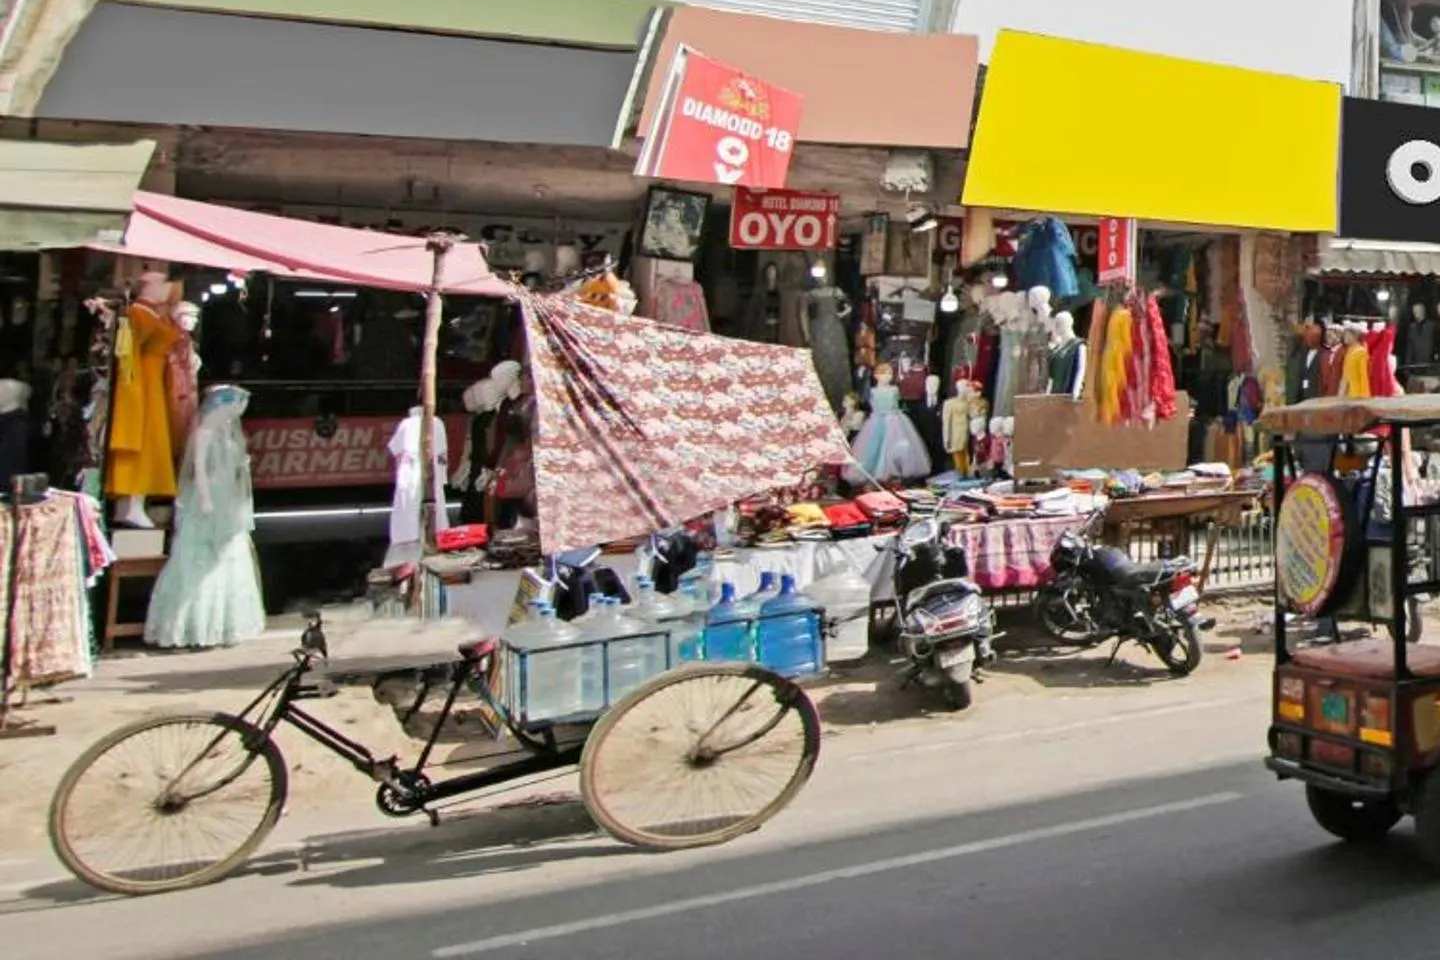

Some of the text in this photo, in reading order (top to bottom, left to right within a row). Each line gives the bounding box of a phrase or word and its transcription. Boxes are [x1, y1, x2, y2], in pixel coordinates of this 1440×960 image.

[764, 125, 793, 153] 18
[738, 212, 823, 247] OYO
[1107, 219, 1119, 267] OYO
[250, 448, 389, 474] ARMEN
